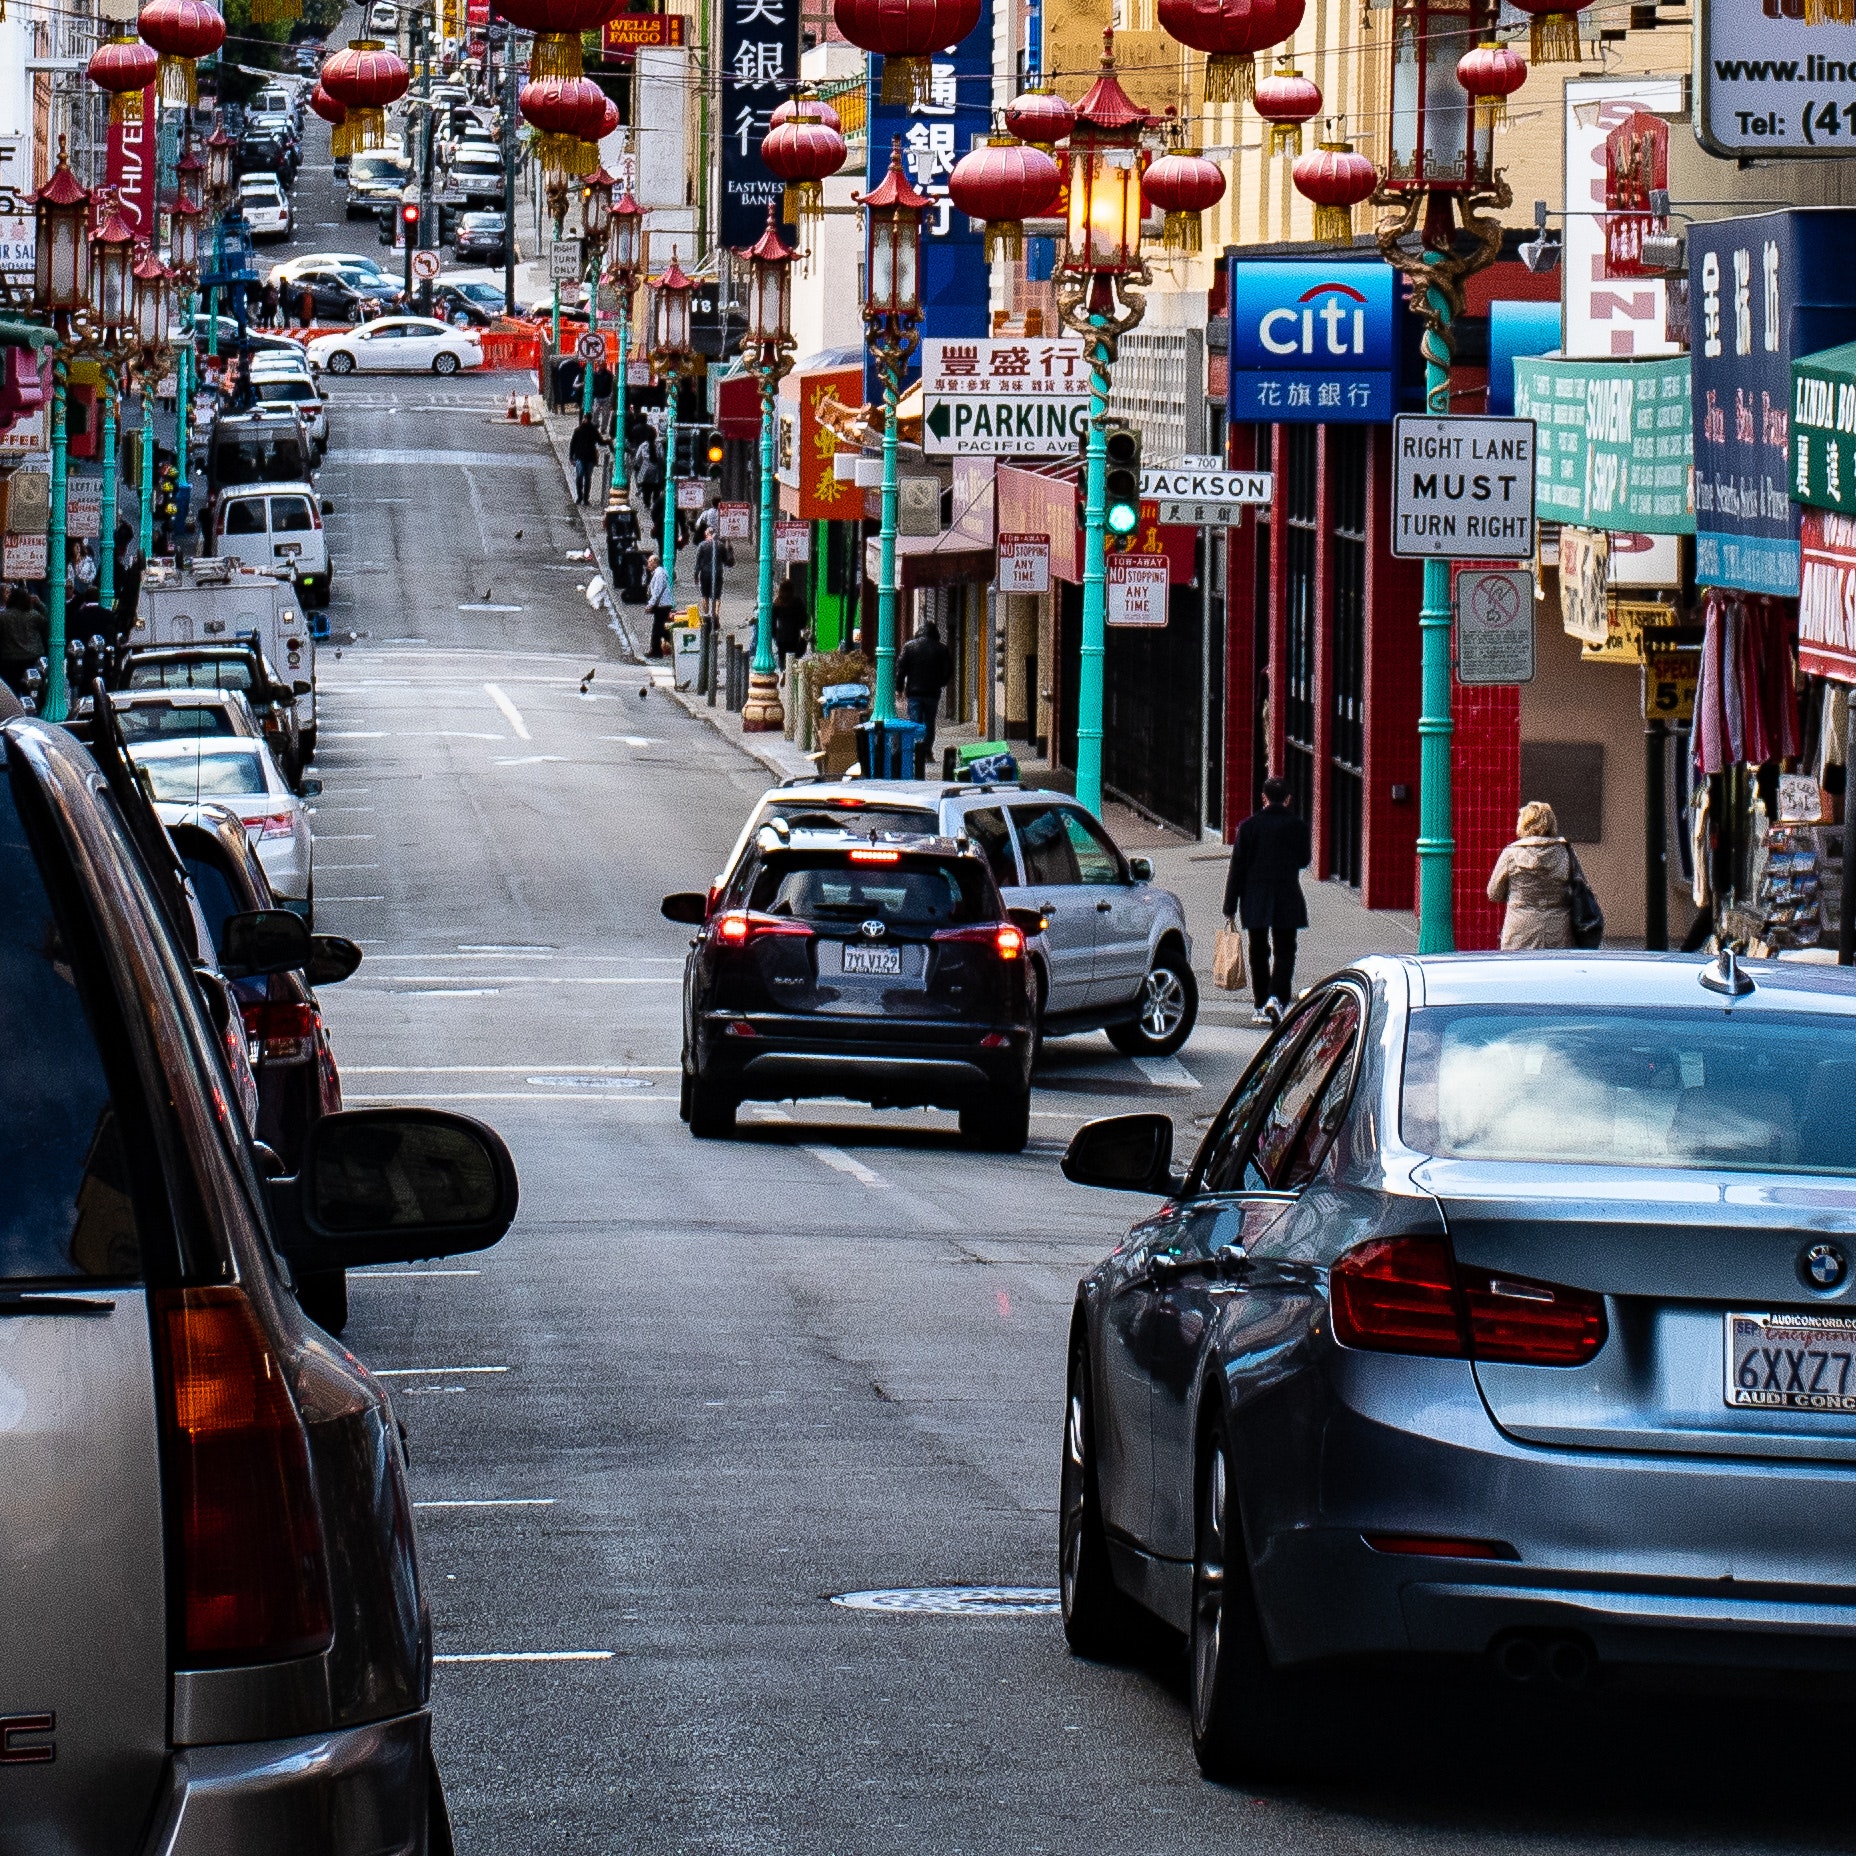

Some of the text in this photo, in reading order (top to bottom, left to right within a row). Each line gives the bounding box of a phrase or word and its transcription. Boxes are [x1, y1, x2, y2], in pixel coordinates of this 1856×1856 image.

[610, 20, 660, 30] WELLS
[611, 32, 660, 42] FARGO
[1737, 112, 1784, 135] Tel:
[742, 194, 775, 205] BANK
[1259, 296, 1365, 353] citi
[941, 347, 1082, 376] 豐盛行
[1258, 383, 1368, 406] 花旗銀行
[1797, 379, 1834, 428] LINDA
[956, 405, 1090, 437] PARKING
[958, 440, 1078, 451] PACIFIC AVE
[1404, 437, 1526, 460] RIGHT LANE
[1197, 457, 1216, 467] 700
[1140, 476, 1263, 496] JACKSON
[1414, 475, 1515, 500] MUST
[1404, 515, 1524, 537] TURN RIGHT
[1000, 544, 1014, 557] NO
[1015, 561, 1033, 570] ANY
[1014, 572, 1033, 581] TIME
[1110, 568, 1165, 583] NO STOPPING
[1127, 587, 1149, 596] ANY
[1126, 600, 1148, 611] TIME
[1657, 683, 1678, 710] 5
[1736, 1391, 1786, 1404] AUDI
